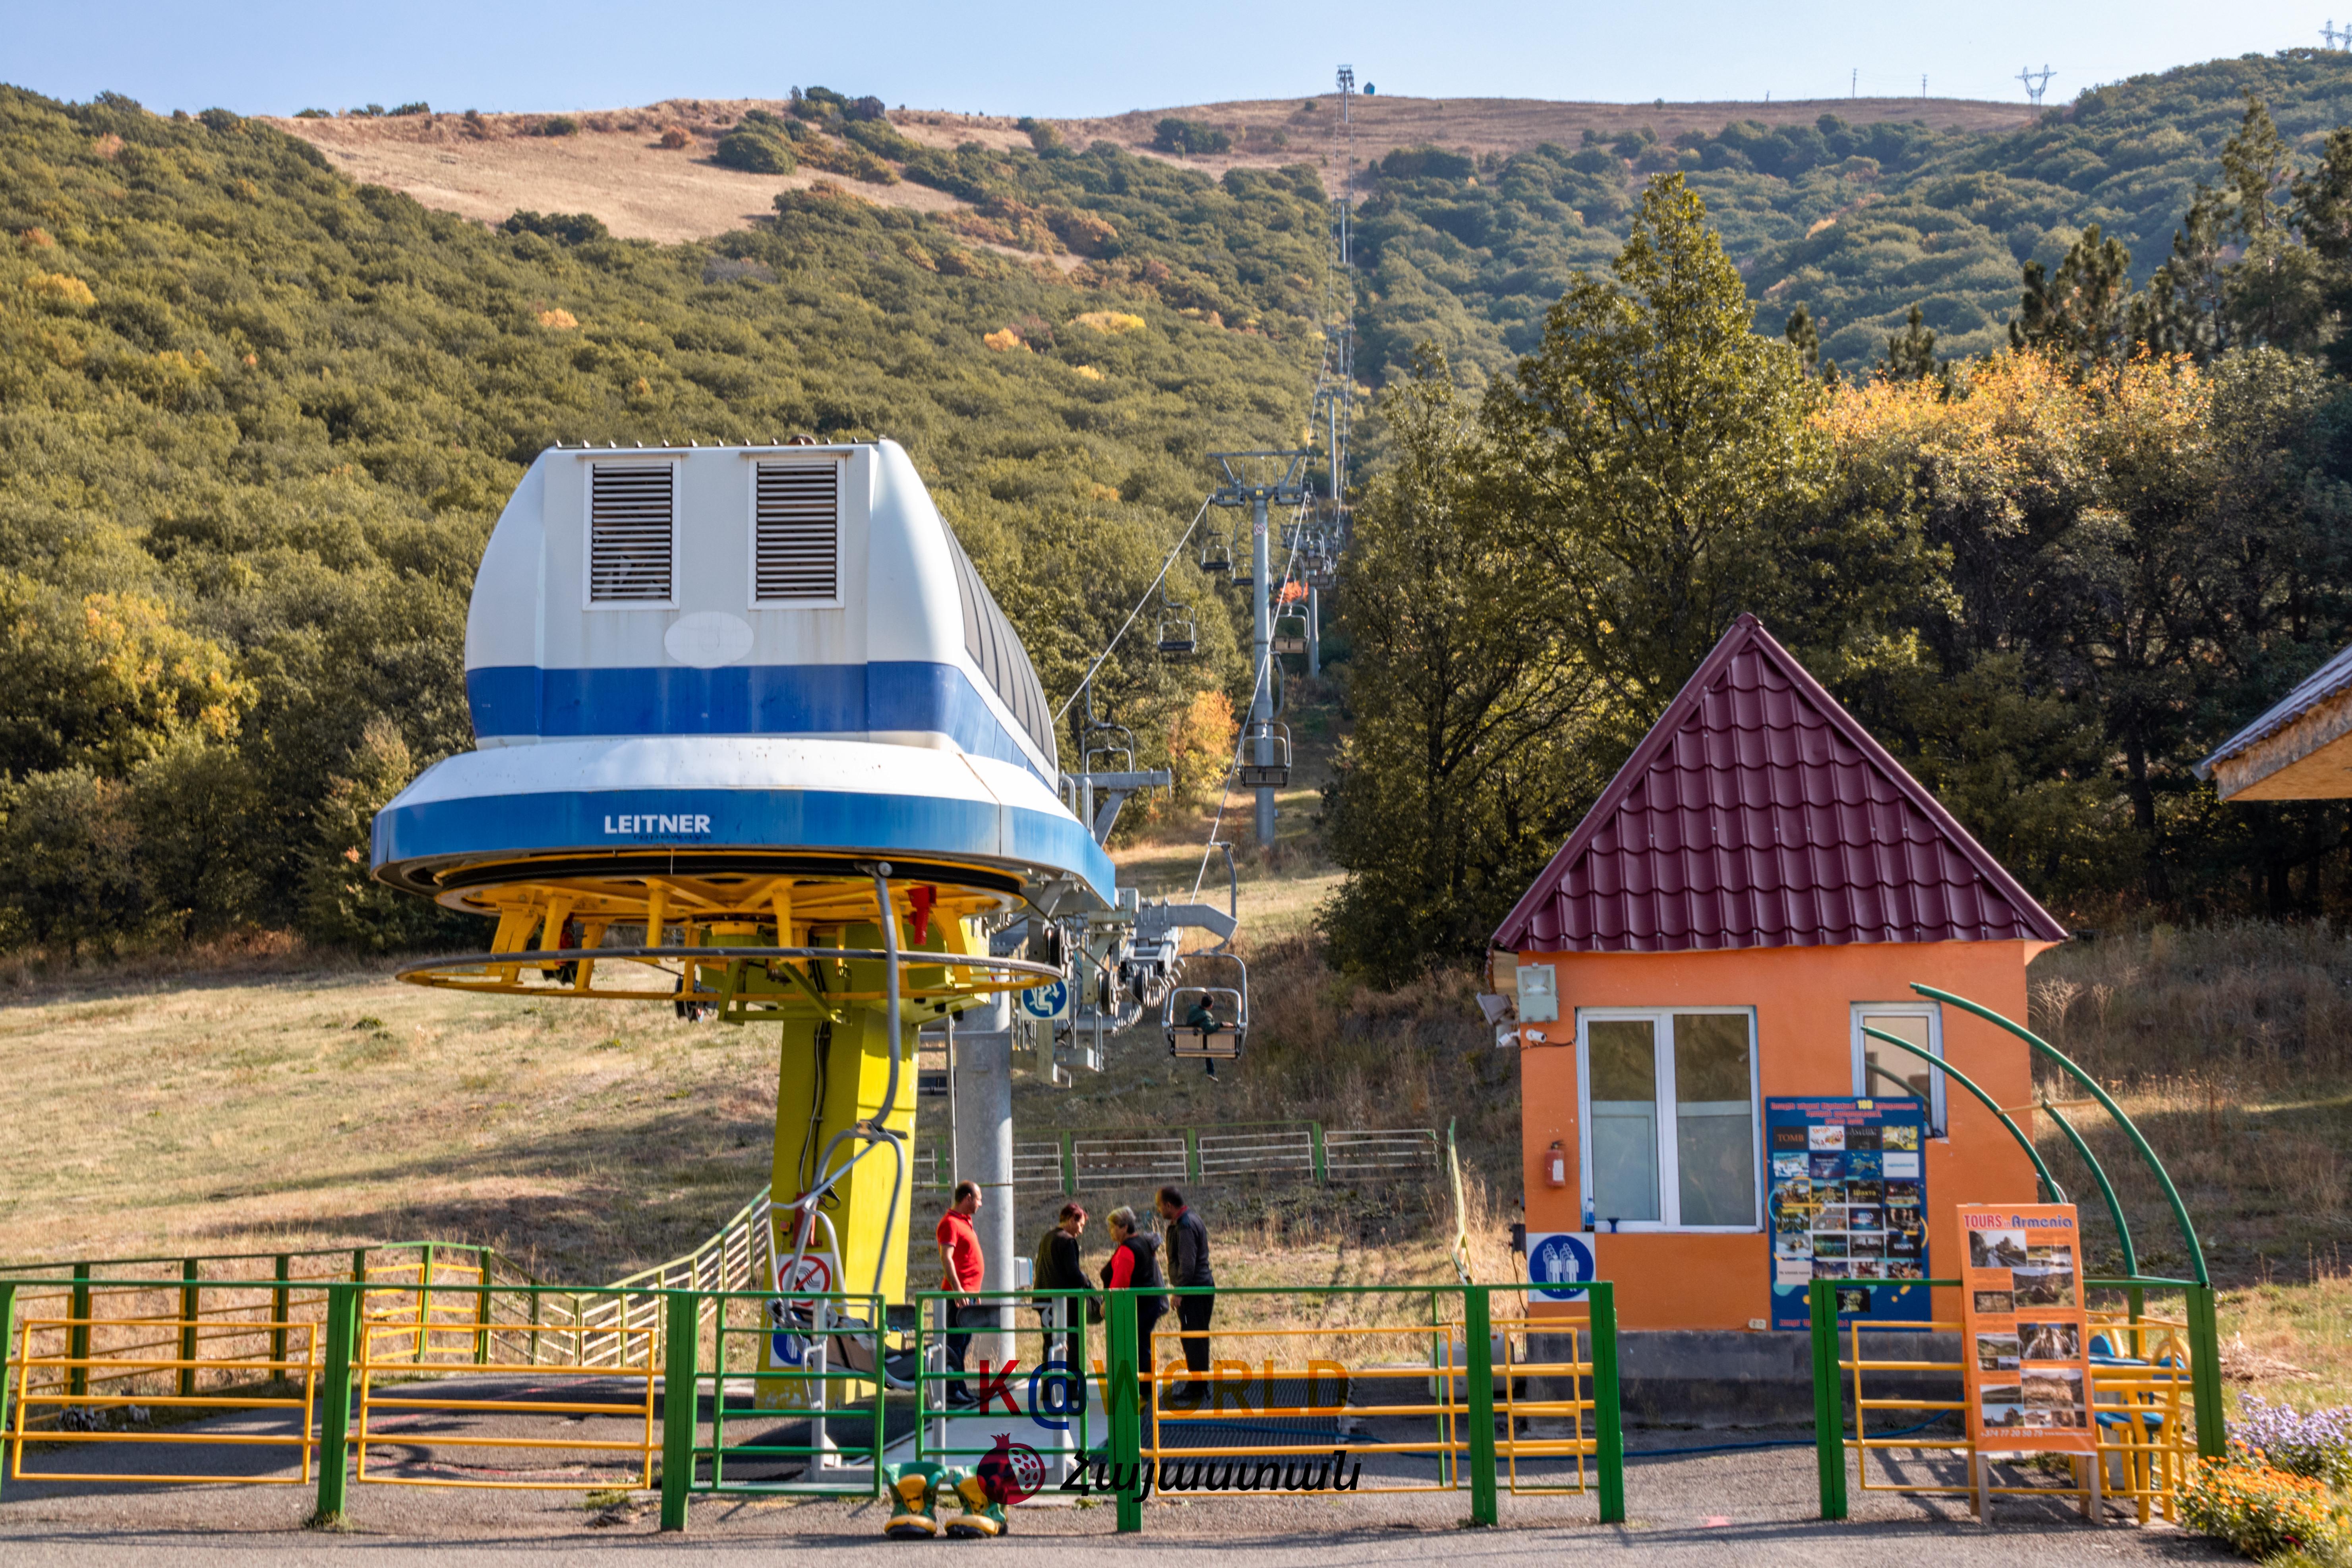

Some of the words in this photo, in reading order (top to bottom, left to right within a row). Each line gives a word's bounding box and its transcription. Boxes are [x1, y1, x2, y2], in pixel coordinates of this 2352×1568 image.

[605, 814, 710, 834] LEITNER
[1857, 1100, 1873, 1109] 100
[1777, 1134, 1804, 1142] TOMB
[1963, 1214, 2002, 1228] TOURS
[2011, 1214, 2073, 1228] Armenia
